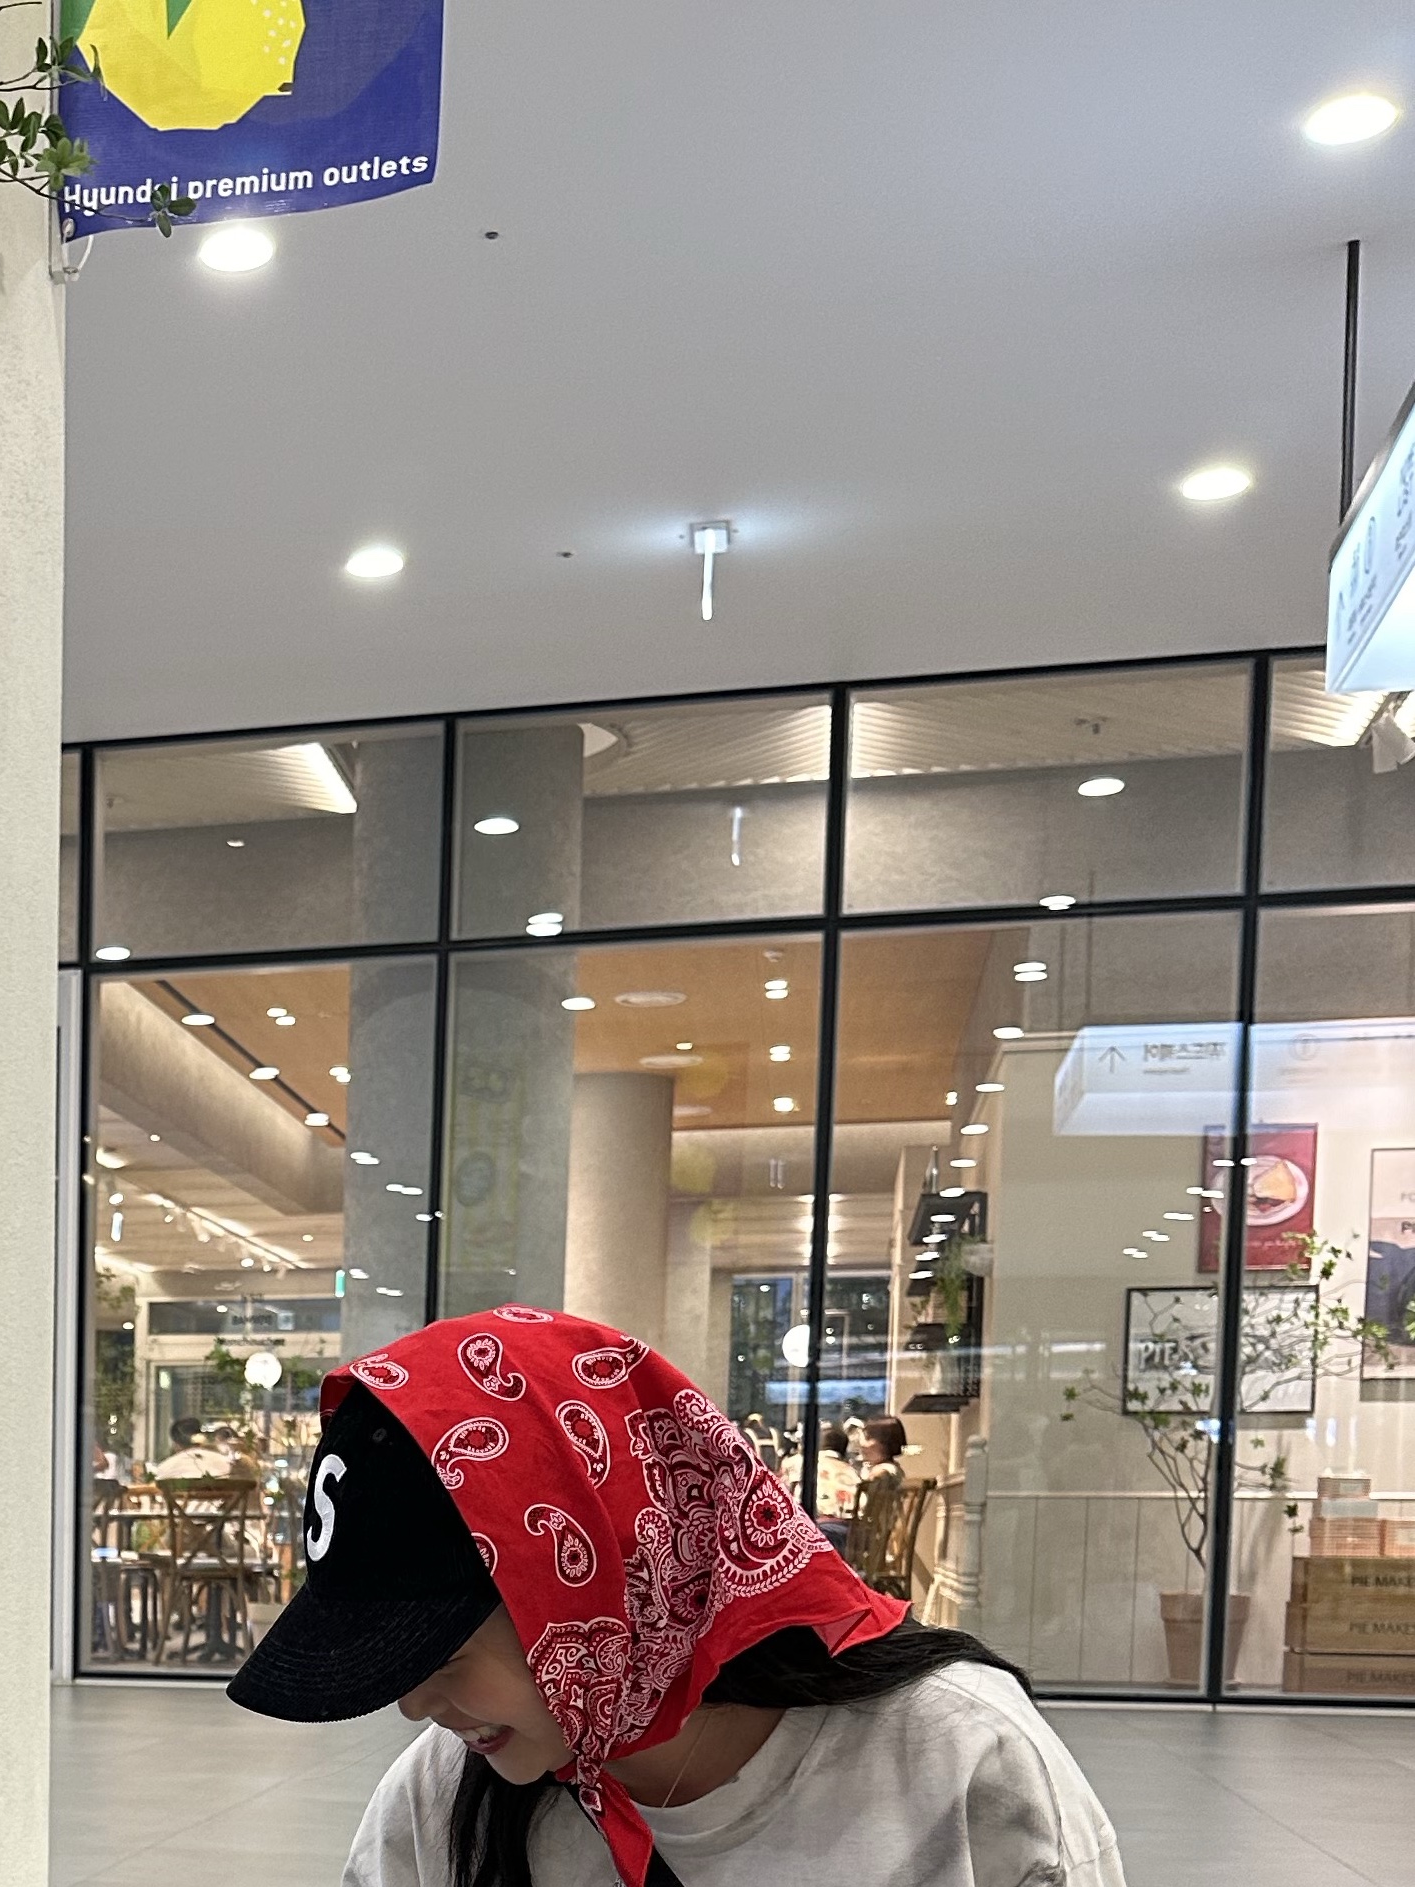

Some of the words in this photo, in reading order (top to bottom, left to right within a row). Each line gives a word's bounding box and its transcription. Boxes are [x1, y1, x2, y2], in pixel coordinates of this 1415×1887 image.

[187, 167, 314, 201] premium
[322, 154, 430, 187] outlets
[306, 1453, 348, 1562] S
